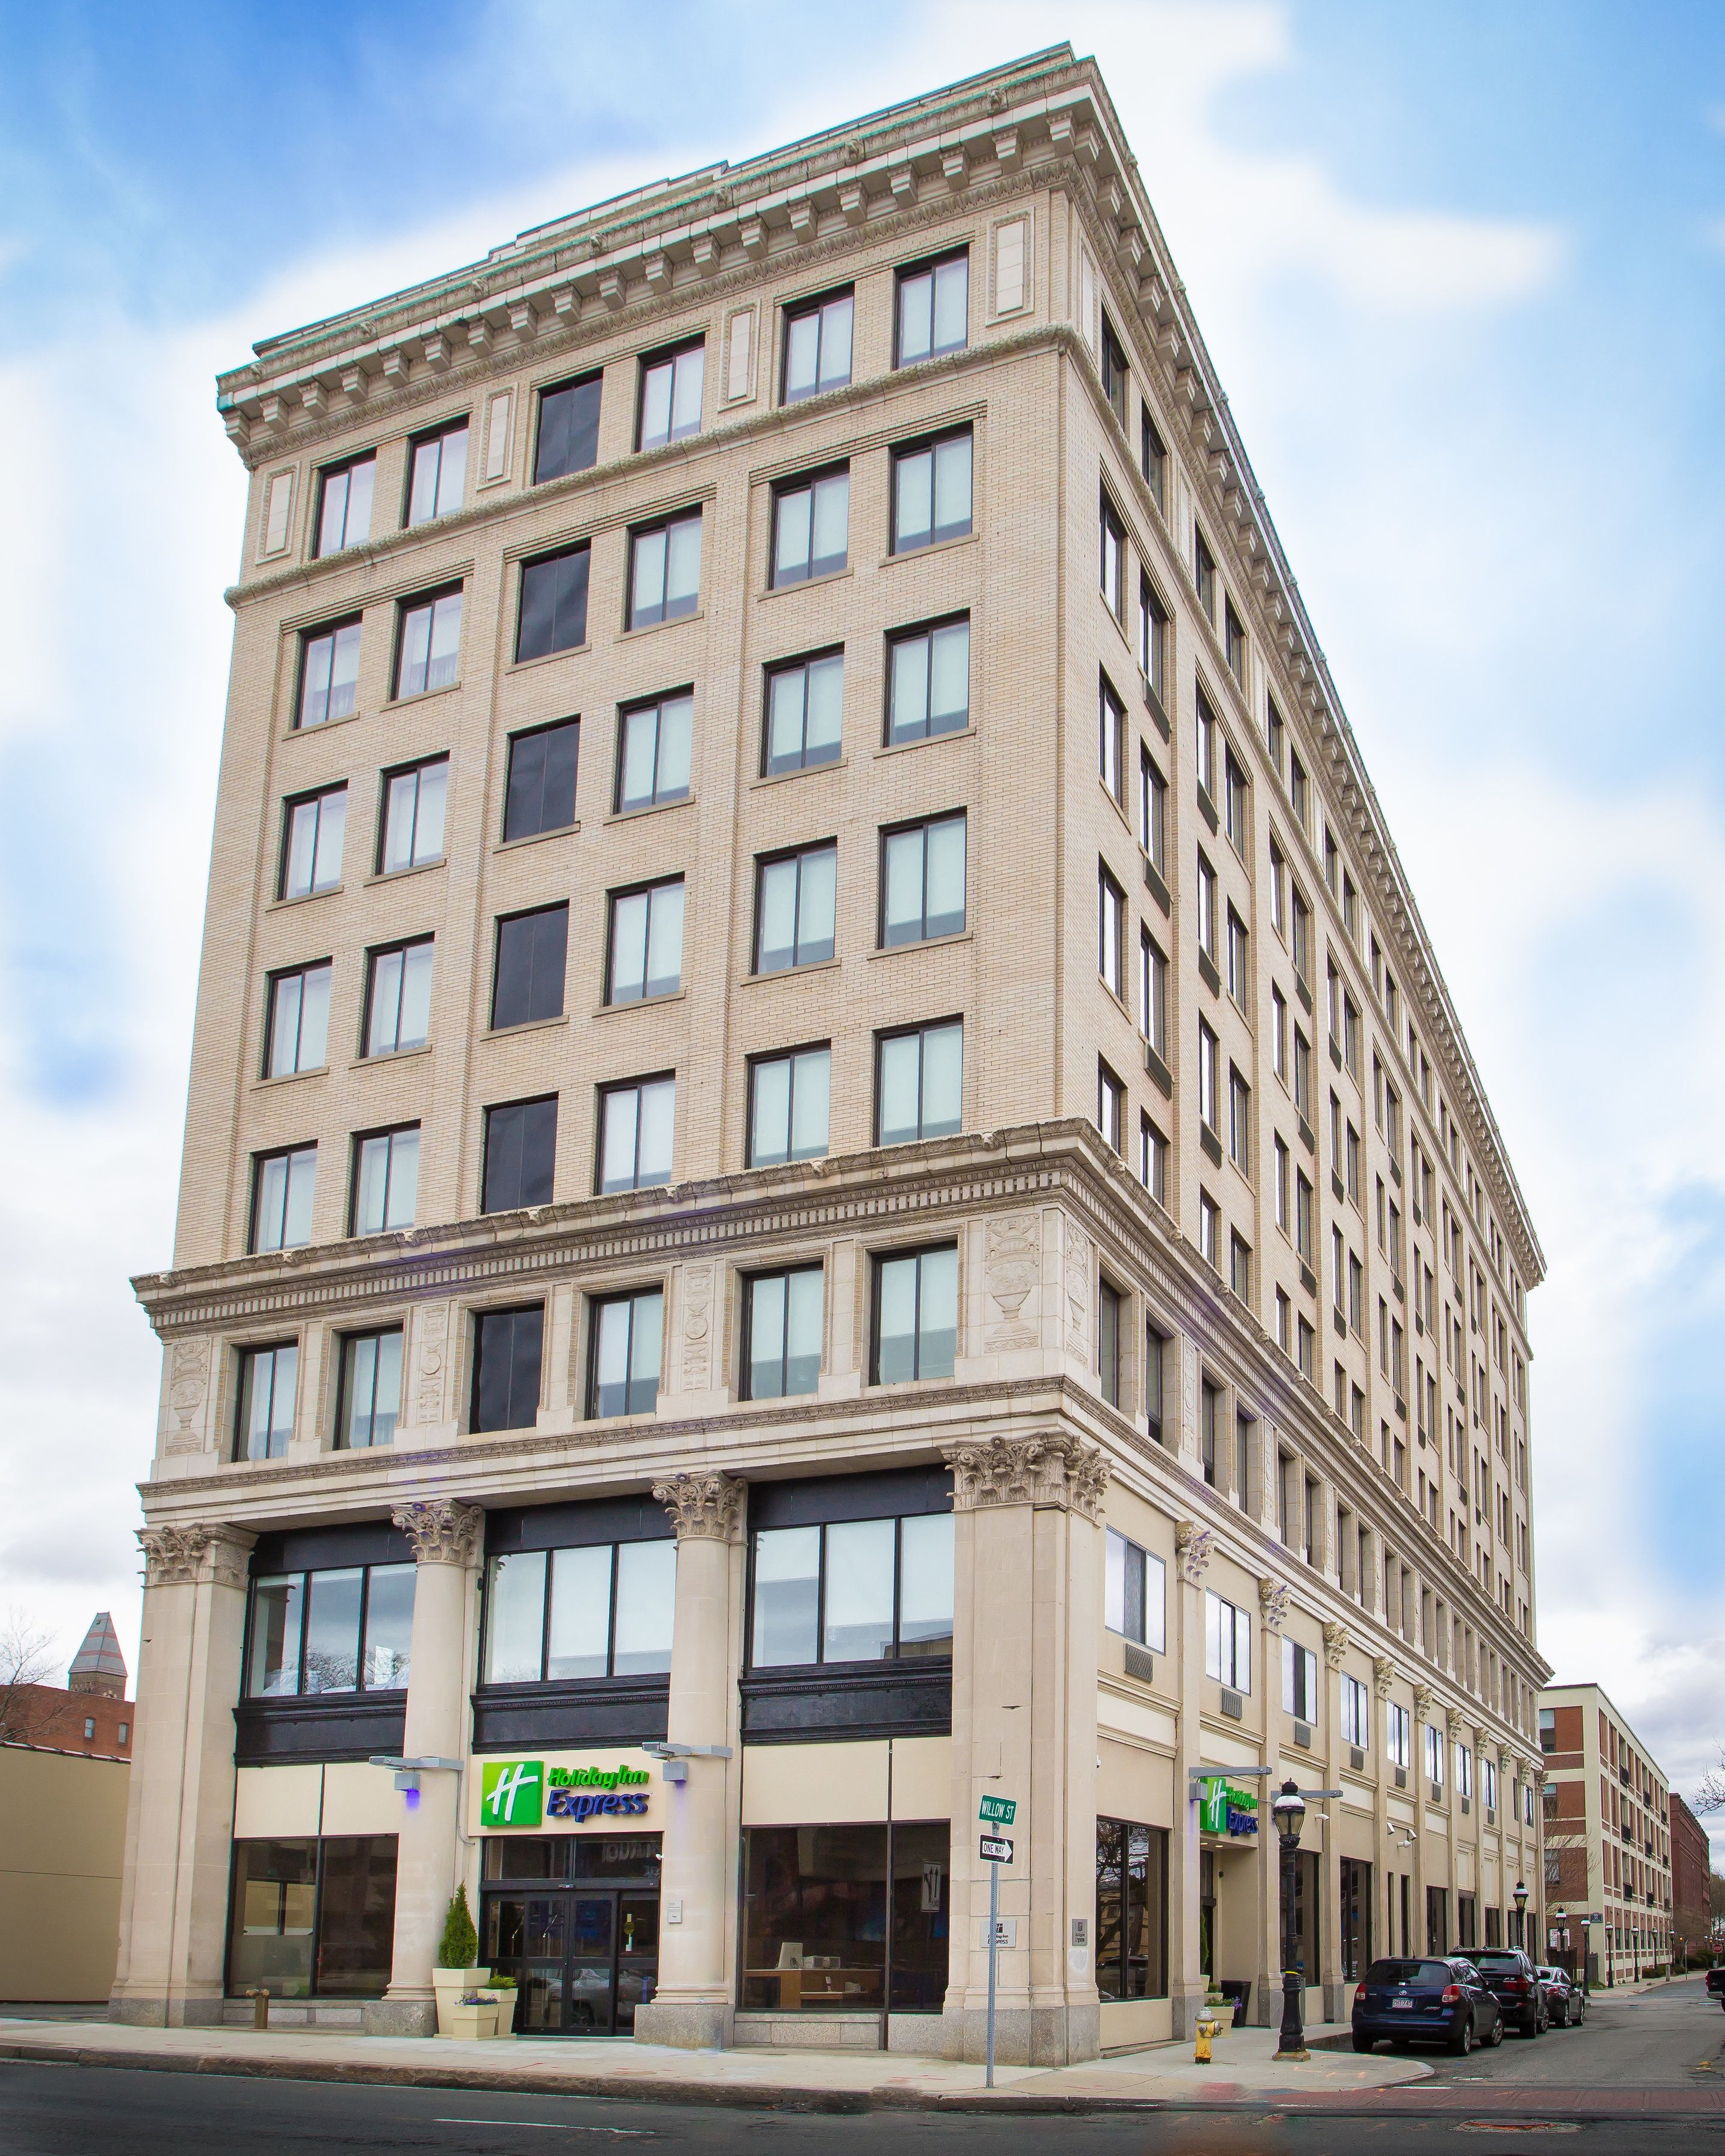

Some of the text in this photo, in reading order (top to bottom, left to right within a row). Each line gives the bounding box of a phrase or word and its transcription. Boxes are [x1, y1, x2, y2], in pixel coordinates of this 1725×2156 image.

[547, 1764, 650, 1789] Holiday Inn
[546, 1789, 650, 1823] Express
[982, 1800, 1014, 1819] WILLOW ST
[1227, 1806, 1258, 1836] Express
[983, 1843, 1004, 1854] ONE WAY
